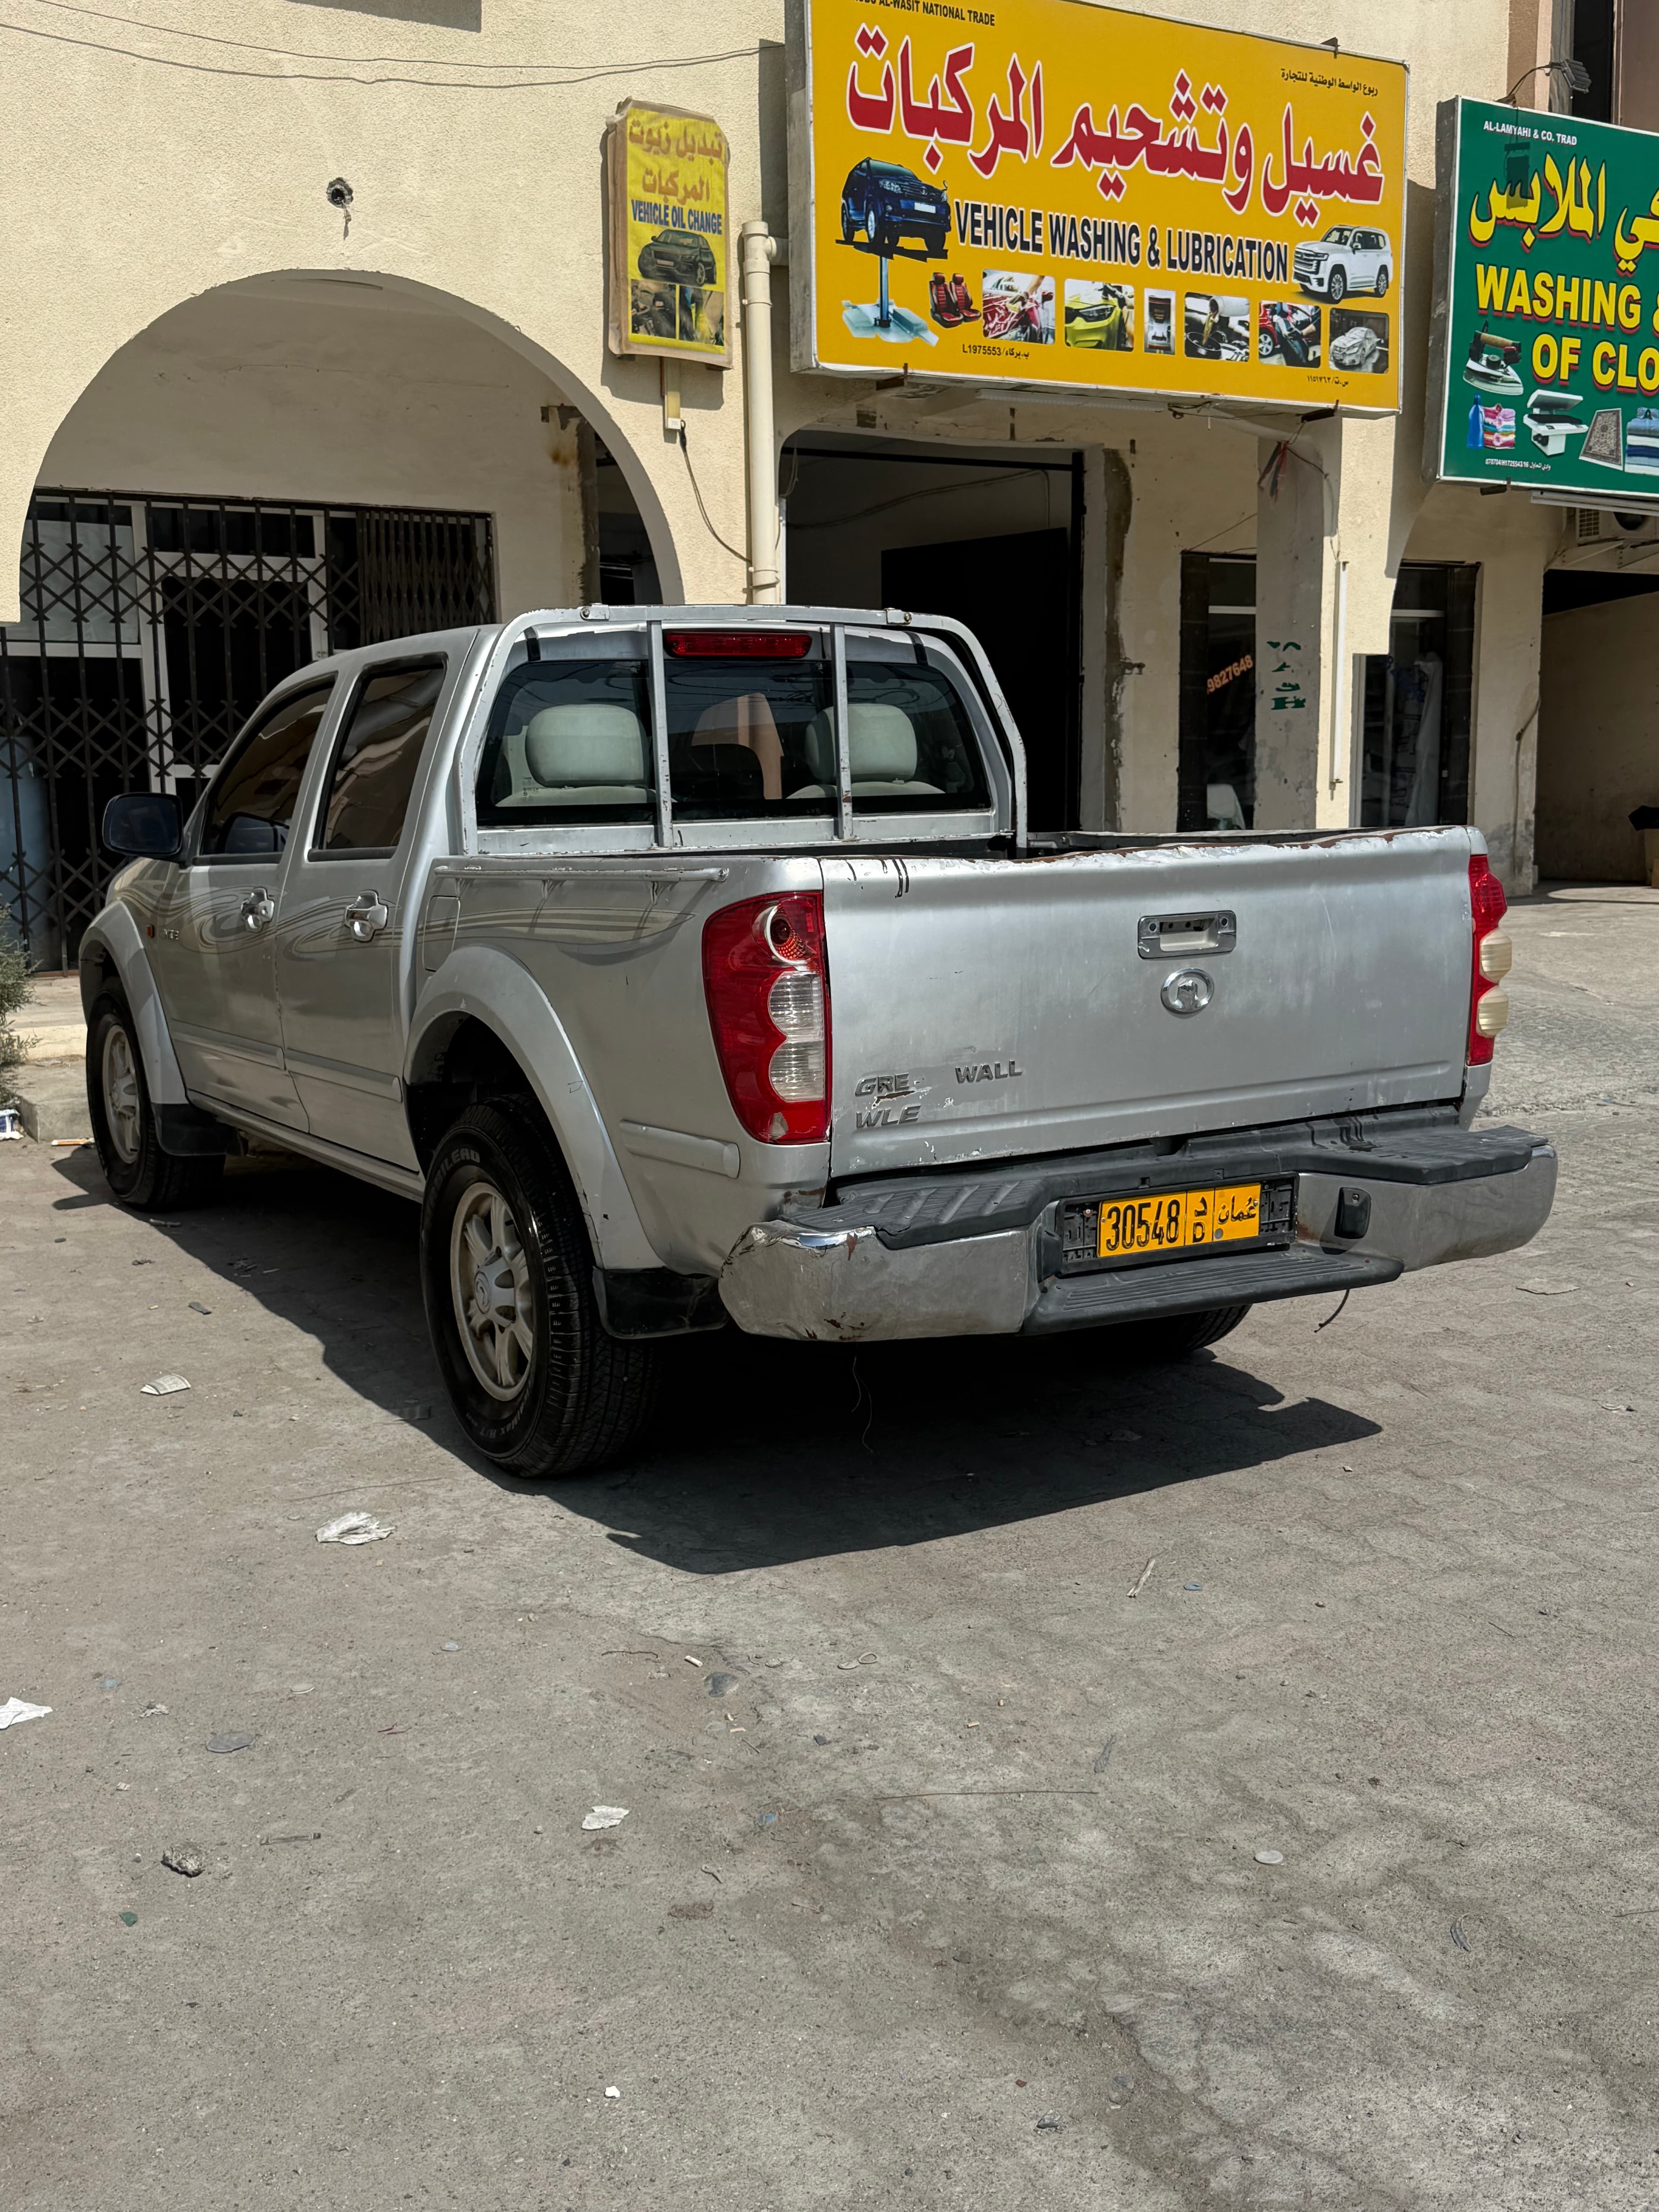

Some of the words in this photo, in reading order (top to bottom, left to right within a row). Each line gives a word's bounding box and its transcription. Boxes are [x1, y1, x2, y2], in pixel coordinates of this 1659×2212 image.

[922, 3, 966, 20] NATIONAL
[967, 10, 995, 26] TRADE
[1281, 68, 1307, 83] للتجارة
[1309, 72, 1336, 89] الوطنية
[1362, 84, 1378, 97] ربوع
[846, 22, 1044, 179] المركبات
[1050, 68, 1254, 215] وتشحيم
[1483, 121, 1531, 138] AL-LAMYAHI
[1533, 129, 1539, 139] &
[1541, 130, 1554, 143] CO.
[1556, 133, 1577, 146] TRAD
[1261, 102, 1385, 229] غسيل
[642, 168, 710, 206] المركبات
[1469, 152, 1606, 251] الملابس
[631, 199, 669, 226] VEHICLE
[671, 206, 686, 229] OIL
[687, 209, 722, 235] CHANGE
[954, 199, 1044, 256] VEHICLE
[1048, 211, 1142, 267] WASHING
[1147, 225, 1161, 270] &
[1167, 227, 1289, 284] LUBRICATION
[1476, 263, 1642, 331] WASHING
[1532, 333, 1582, 382] OF
[954, 1060, 1023, 1084] WALL
[855, 1104, 922, 1129] WLE
[1194, 1196, 1208, 1217] د
[1106, 1199, 1180, 1251] 30548
[1192, 1221, 1205, 1243] D
